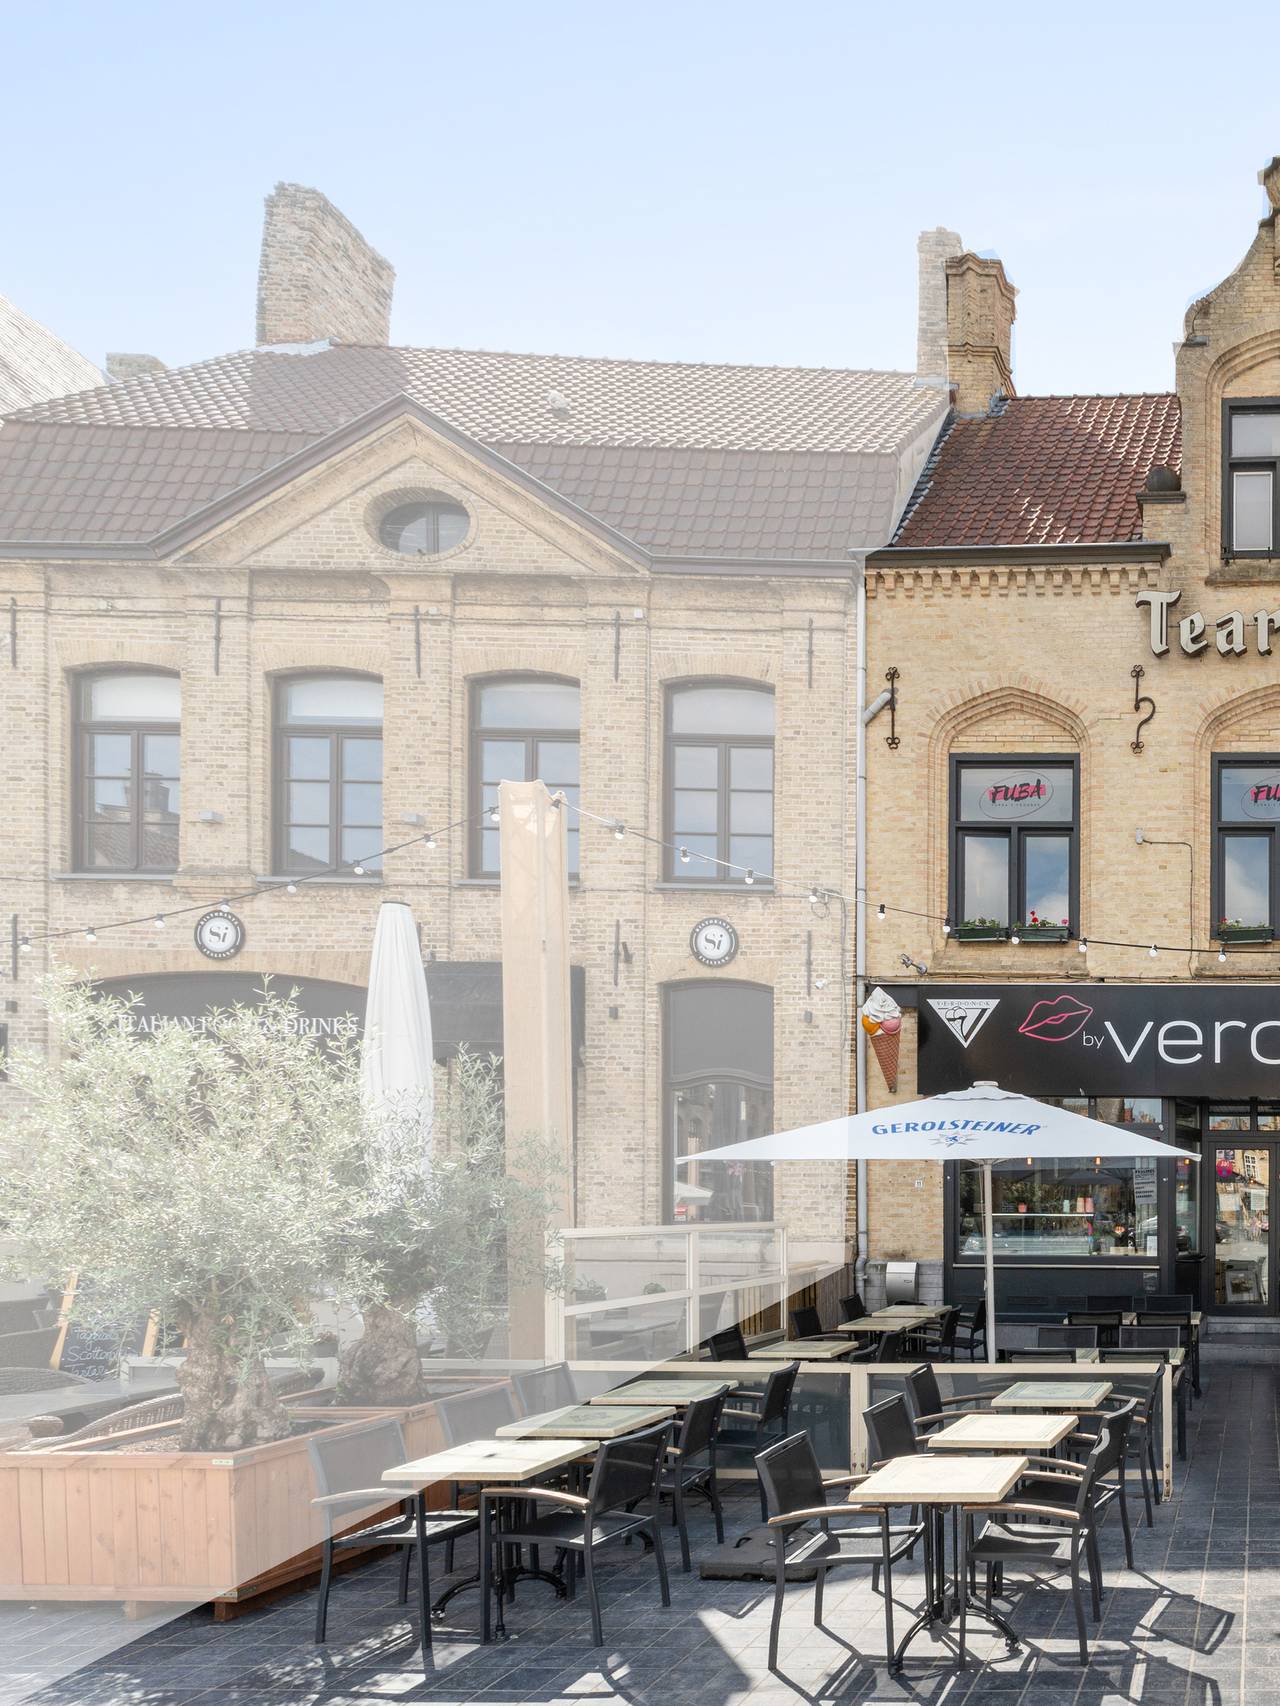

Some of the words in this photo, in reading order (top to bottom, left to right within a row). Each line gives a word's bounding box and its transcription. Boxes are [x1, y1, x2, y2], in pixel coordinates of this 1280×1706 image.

[991, 778, 1042, 804] FUBA
[209, 926, 229, 943] Si
[704, 933, 723, 951] Si
[1082, 1031, 1105, 1049] by
[872, 1119, 1041, 1136] GEROLSTEINER
